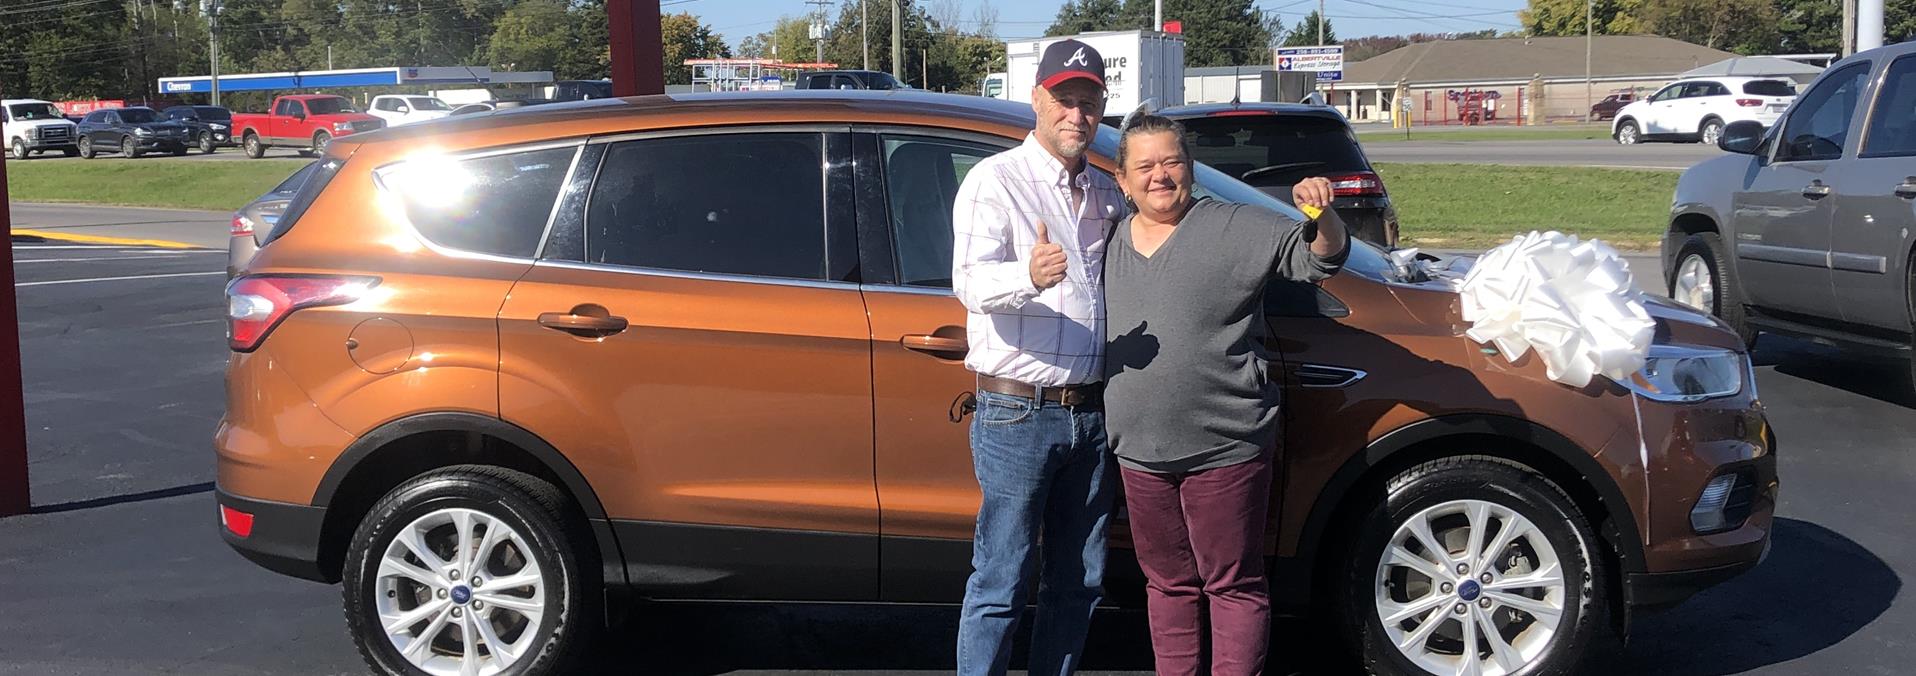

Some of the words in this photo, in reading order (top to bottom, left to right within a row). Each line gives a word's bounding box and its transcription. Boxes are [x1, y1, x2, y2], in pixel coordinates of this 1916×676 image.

[1064, 47, 1088, 67] A
[1104, 56, 1127, 69] ure
[1294, 62, 1316, 70] Express
[1317, 61, 1341, 69] Storage
[1105, 71, 1122, 82] ed
